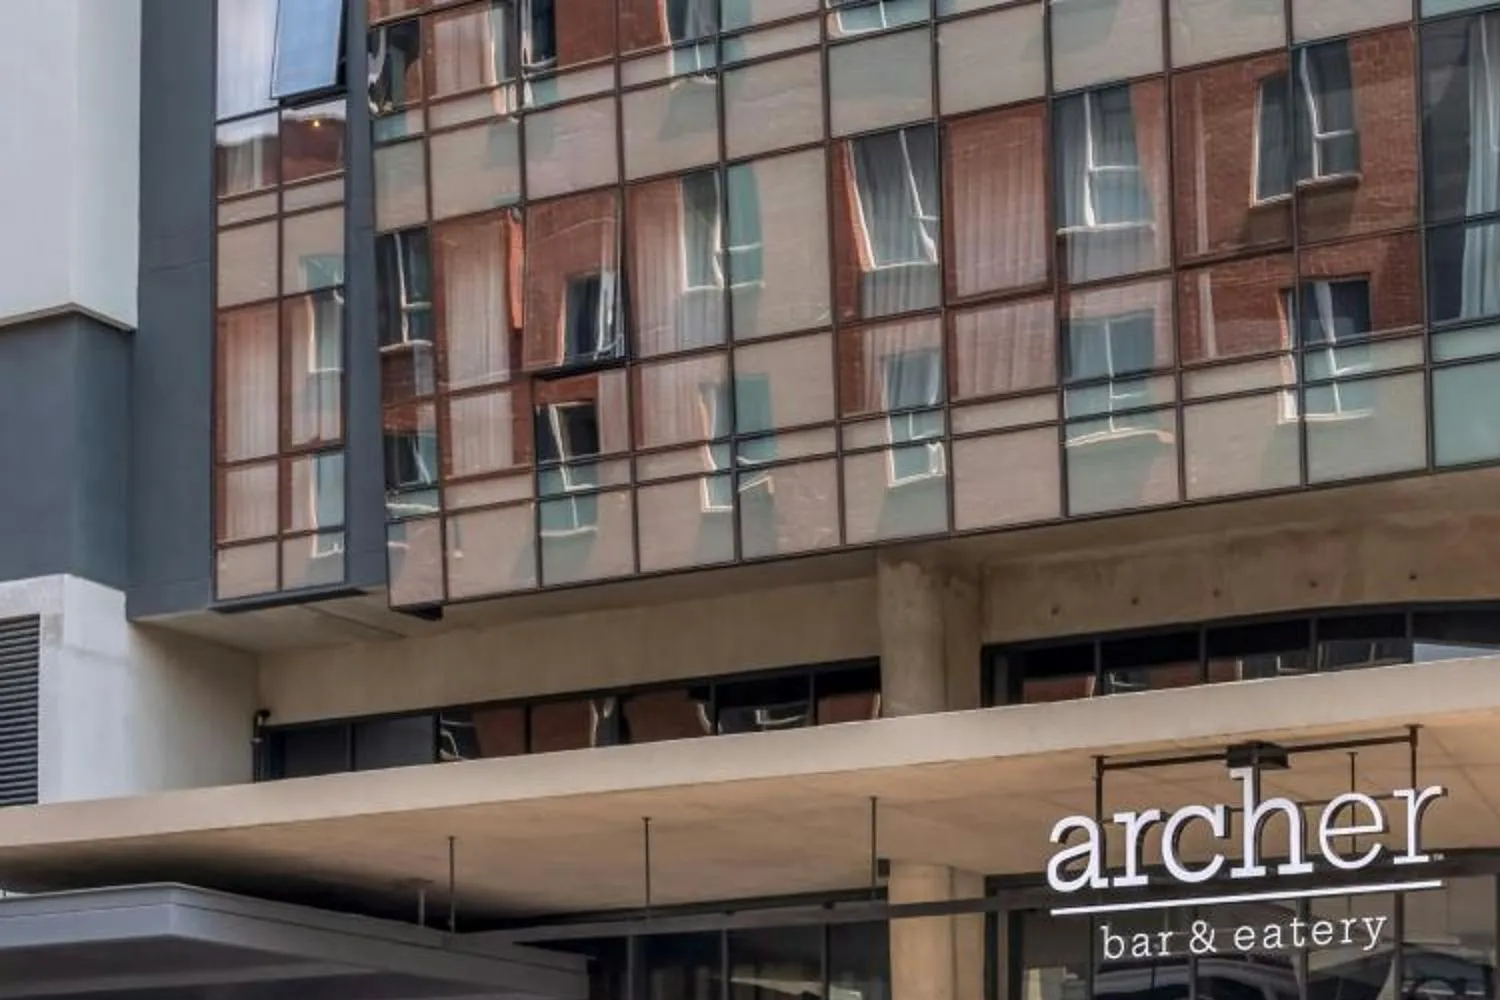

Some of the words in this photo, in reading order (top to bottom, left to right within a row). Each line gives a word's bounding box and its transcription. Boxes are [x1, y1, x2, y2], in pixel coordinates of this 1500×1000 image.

[1046, 767, 1445, 893] archer
[1101, 925, 1174, 960] bar
[1189, 919, 1217, 954] &
[1233, 915, 1388, 951] eatery
